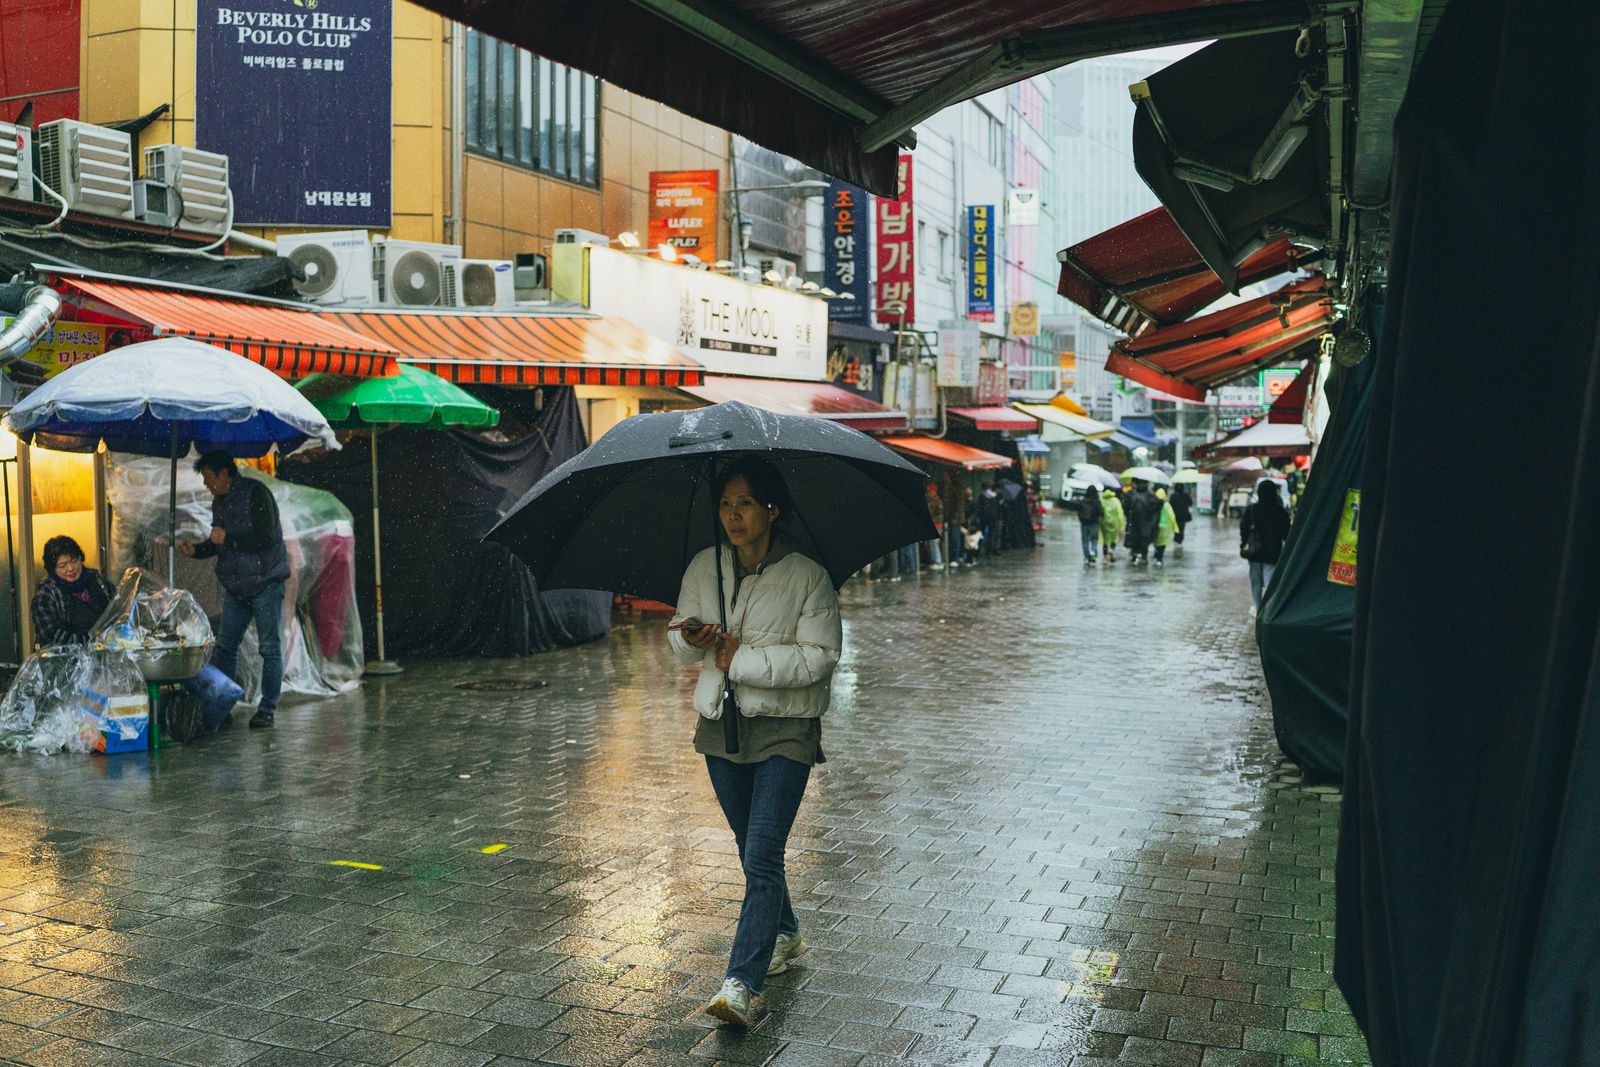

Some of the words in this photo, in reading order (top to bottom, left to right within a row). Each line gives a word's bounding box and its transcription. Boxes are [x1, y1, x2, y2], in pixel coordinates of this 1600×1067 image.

[217, 8, 308, 29] BEVERLY
[312, 12, 371, 32] HILLS
[237, 27, 293, 45] POLO
[304, 191, 372, 207] 남대문본점
[701, 298, 730, 333] THE
[736, 304, 780, 340] MOOL
